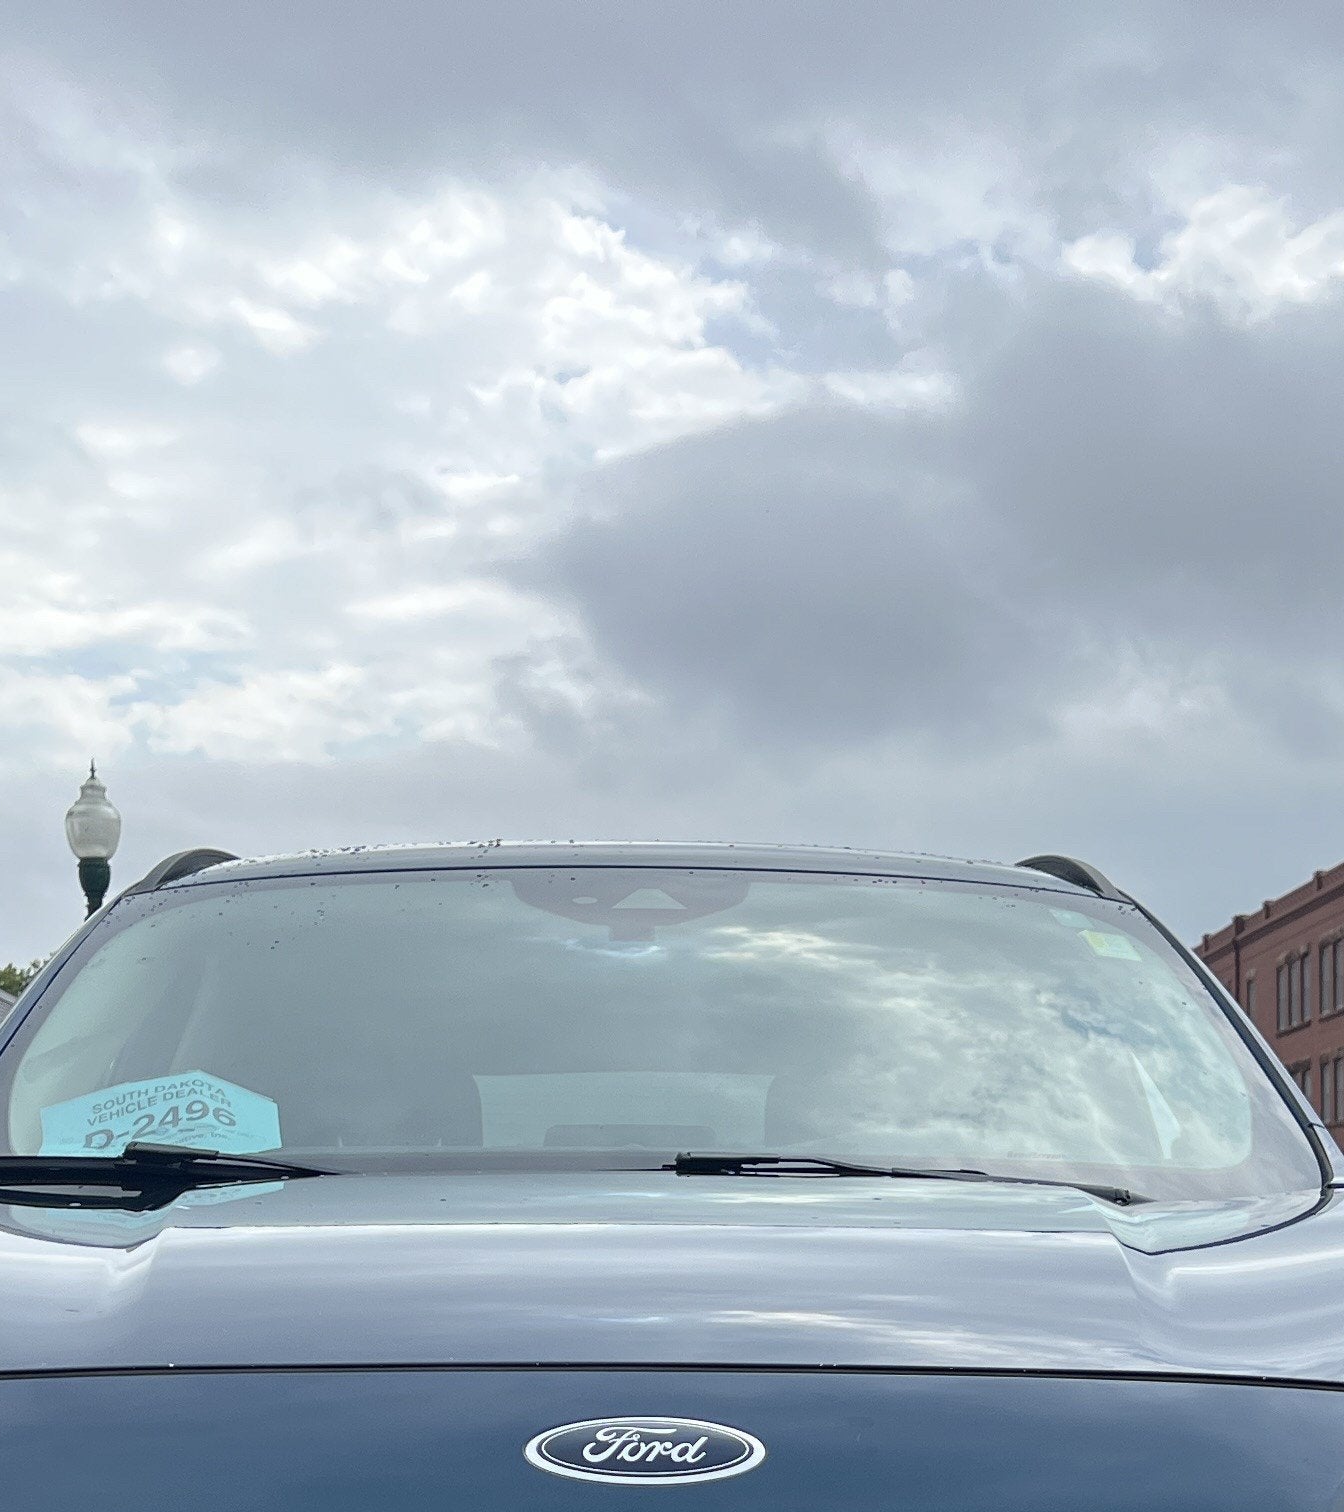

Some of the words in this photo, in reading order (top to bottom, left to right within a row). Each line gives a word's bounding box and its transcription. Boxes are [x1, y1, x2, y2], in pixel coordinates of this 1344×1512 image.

[86, 1097, 158, 1127] VEHICLE
[162, 1086, 232, 1108] DEALER
[91, 1087, 151, 1115] SOUTH
[154, 1078, 226, 1098] DAKOTA
[82, 1099, 237, 1150] D-2496
[582, 1426, 709, 1463] Ford
